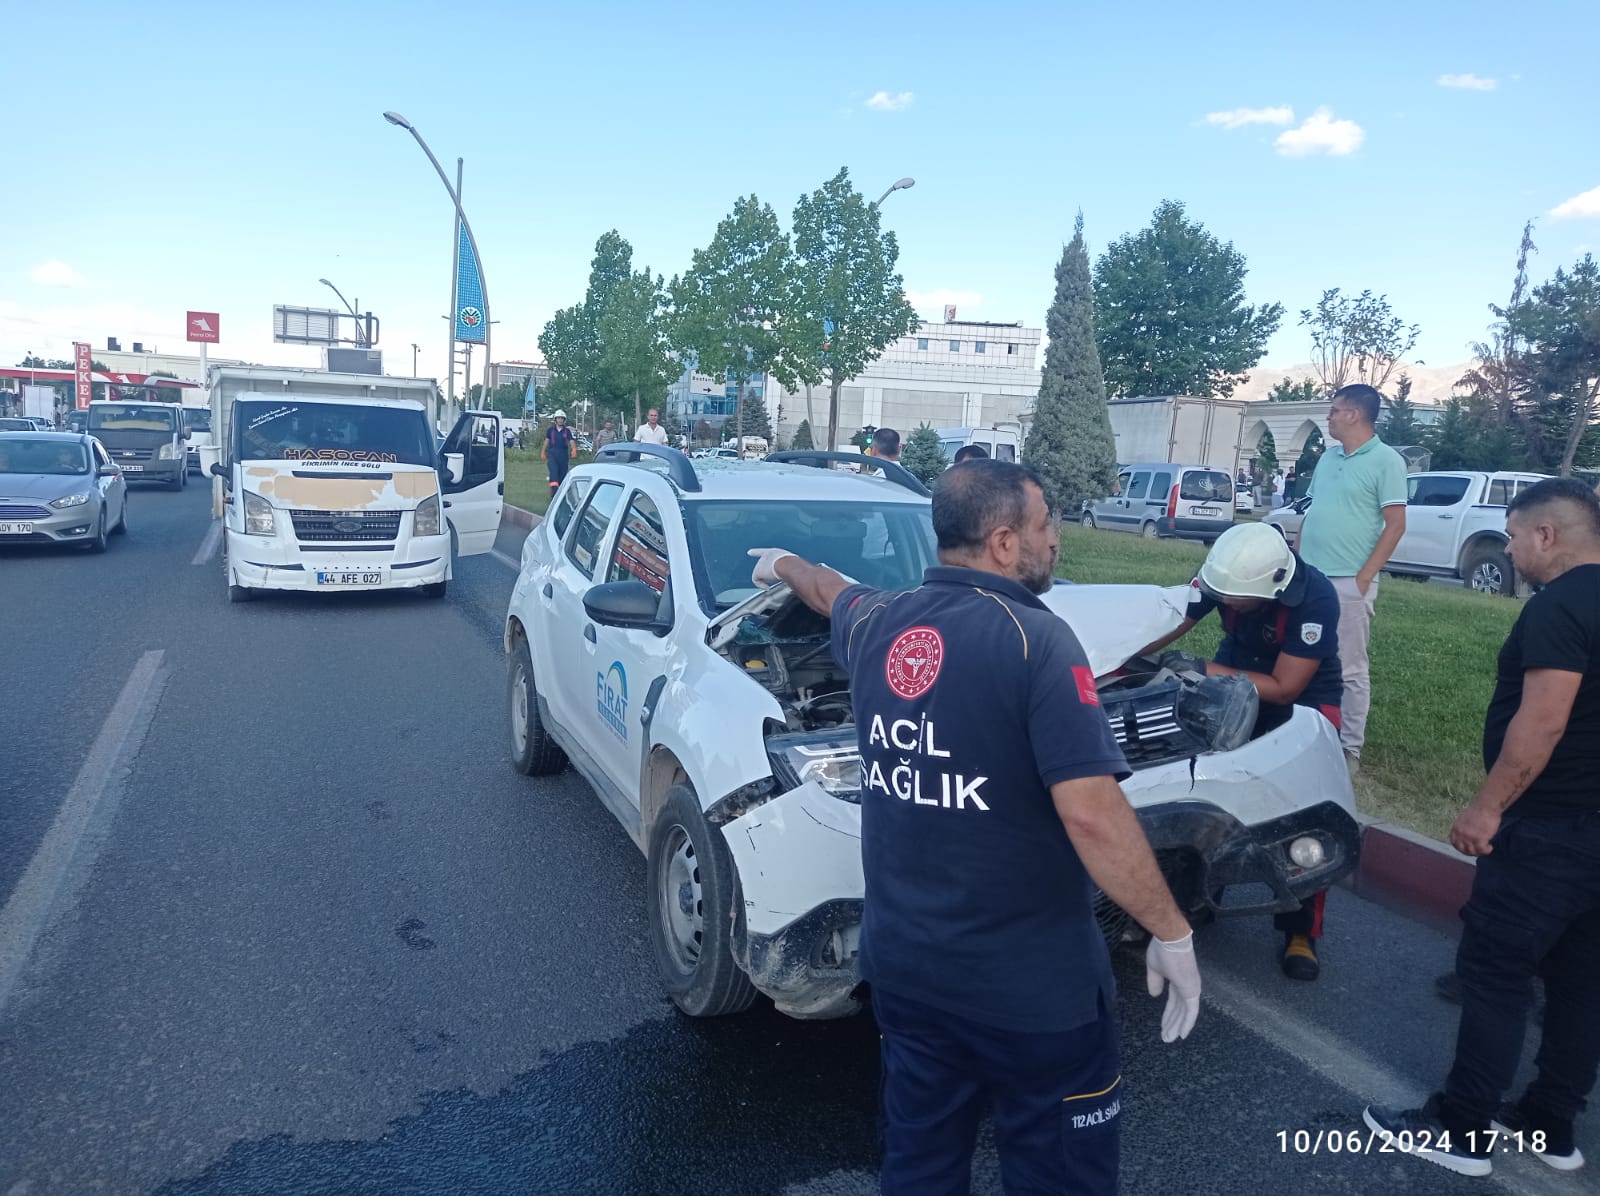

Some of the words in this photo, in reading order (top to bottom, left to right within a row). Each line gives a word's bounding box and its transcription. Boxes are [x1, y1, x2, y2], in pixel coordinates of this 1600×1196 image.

[79, 345, 90, 409] PEKEL
[17, 523, 31, 532] 170
[324, 573, 335, 583] 44
[341, 573, 358, 583] AFE
[363, 573, 380, 583] 027
[1071, 1114, 1086, 1129] 112
